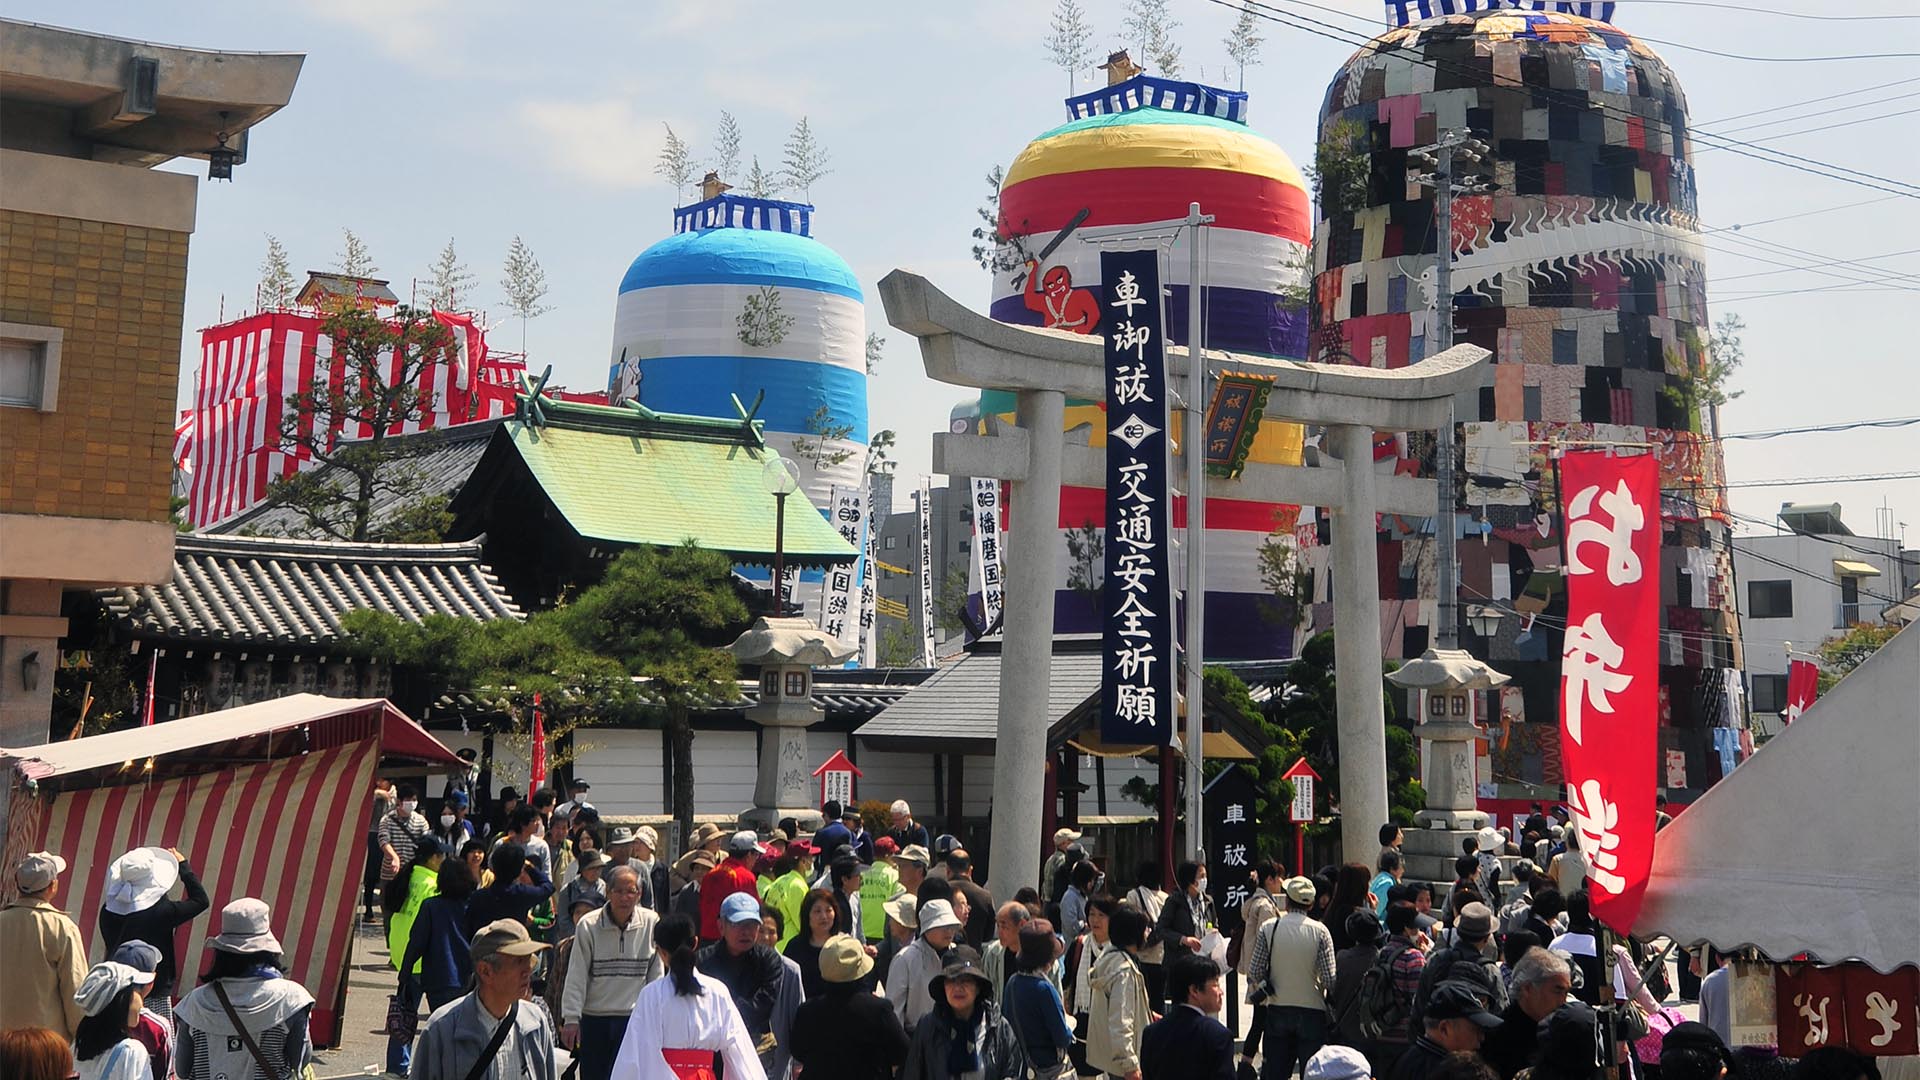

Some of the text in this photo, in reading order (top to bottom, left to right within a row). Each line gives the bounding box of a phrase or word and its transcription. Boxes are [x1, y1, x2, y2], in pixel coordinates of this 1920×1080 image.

[1110, 269, 1158, 727] 車御祓 交通安全祈願
[1222, 803, 1250, 909] 車祓所
